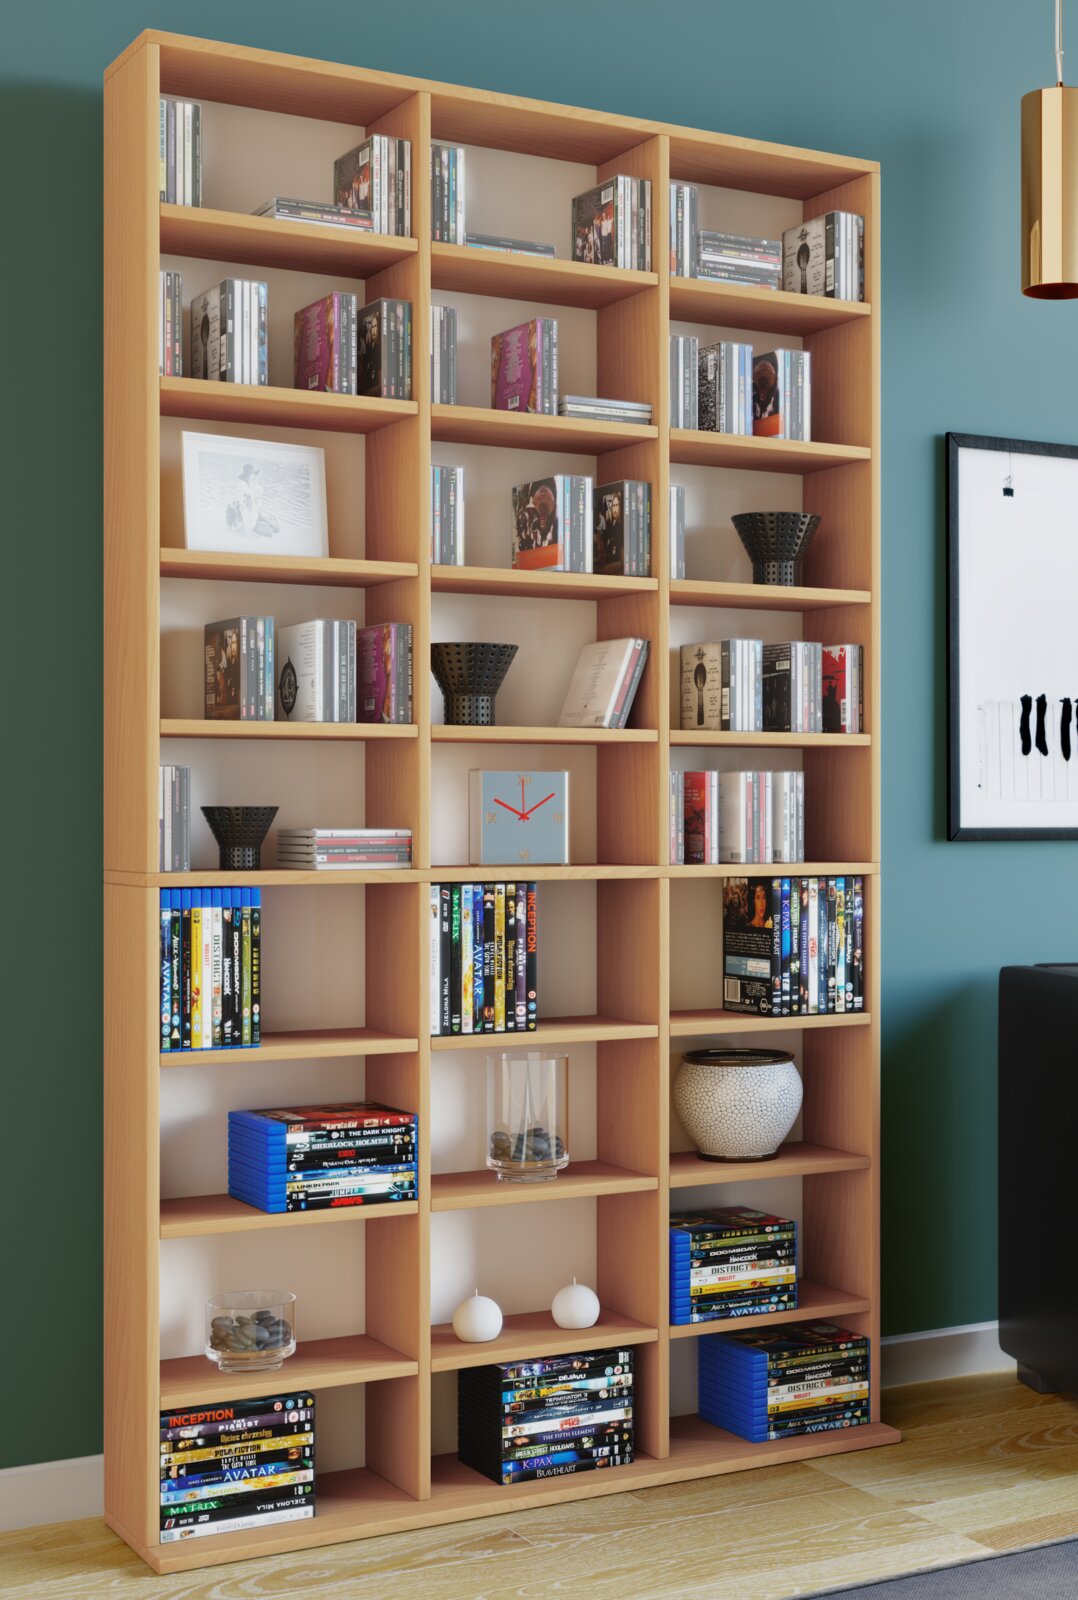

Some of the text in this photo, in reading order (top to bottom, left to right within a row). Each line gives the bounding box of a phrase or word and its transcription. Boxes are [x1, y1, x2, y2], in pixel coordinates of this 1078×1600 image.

[452, 894, 460, 940] MATRIX
[782, 900, 790, 931] K-PAX
[527, 892, 537, 953] INCEPTION
[213, 935, 221, 983] DISTRICT
[473, 944, 482, 995] AVATAR
[162, 961, 170, 1013] AVATAR
[311, 1137, 388, 1150] SHERLOCK HOLMES
[331, 1196, 364, 1207] JAWS
[710, 1246, 758, 1257] DOOMSDAY
[730, 1253, 758, 1263] HANCOCK
[712, 1264, 750, 1275] DISTRICT
[730, 1305, 768, 1317] AVATAR
[786, 1363, 833, 1375] DOOMSDAY
[805, 1370, 833, 1381] HANCOCK
[787, 1381, 826, 1393] DISTRICT
[545, 1394, 583, 1403] TERMINATOR
[170, 1408, 235, 1428] INCEPTION
[219, 1420, 260, 1432] PIANIST
[805, 1422, 842, 1433] AVATAR
[554, 1432, 571, 1440] FIFTH
[571, 1428, 596, 1437] ELEMENT
[214, 1444, 262, 1458] PULP FICTION
[549, 1442, 575, 1452] HOOLIGANS
[522, 1456, 553, 1470] K-PAX
[223, 1465, 278, 1483] AVATAR
[536, 1465, 577, 1479] BRAVEHEART
[170, 1501, 218, 1517] MATRIX
[256, 1498, 307, 1511] ZIELONA MILA
